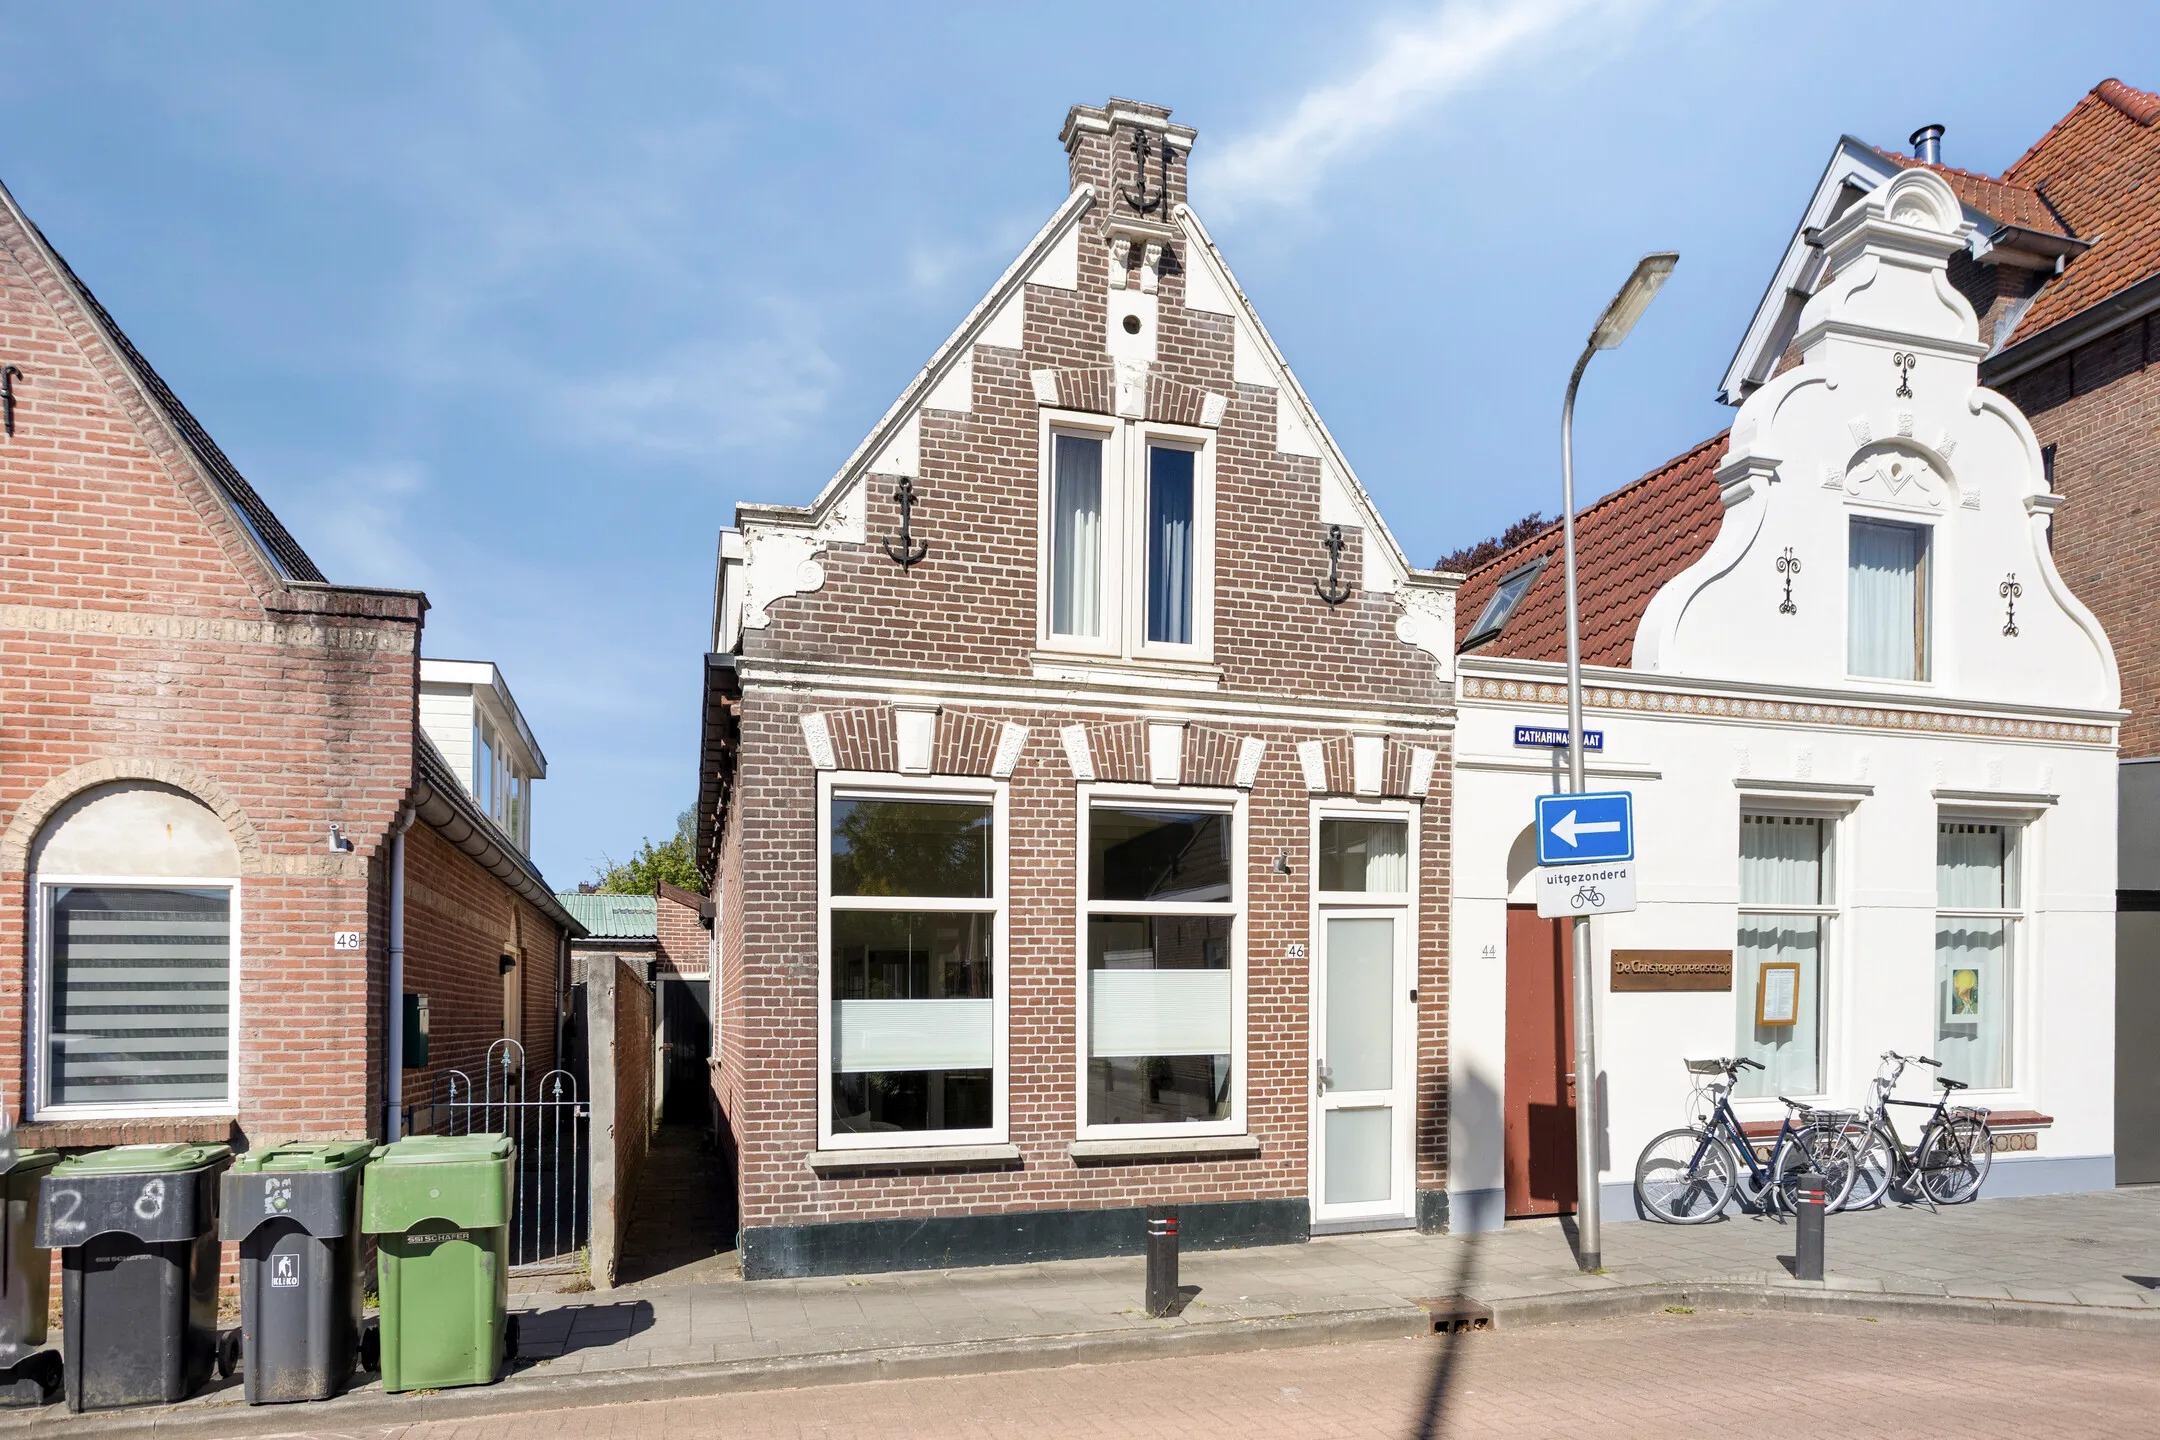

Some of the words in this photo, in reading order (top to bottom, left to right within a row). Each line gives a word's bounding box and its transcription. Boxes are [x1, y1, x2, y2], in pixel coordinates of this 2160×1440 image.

[1518, 730, 1600, 746] CATHARINAAAT
[1547, 869, 1626, 886] uitgezonderd
[337, 933, 358, 948] 48
[1289, 945, 1304, 958] 46
[1482, 944, 1496, 957] 44
[1615, 962, 1631, 974] De
[51, 1189, 86, 1231] 2
[134, 1179, 165, 1219] 8
[273, 1277, 298, 1286] KLIKO
